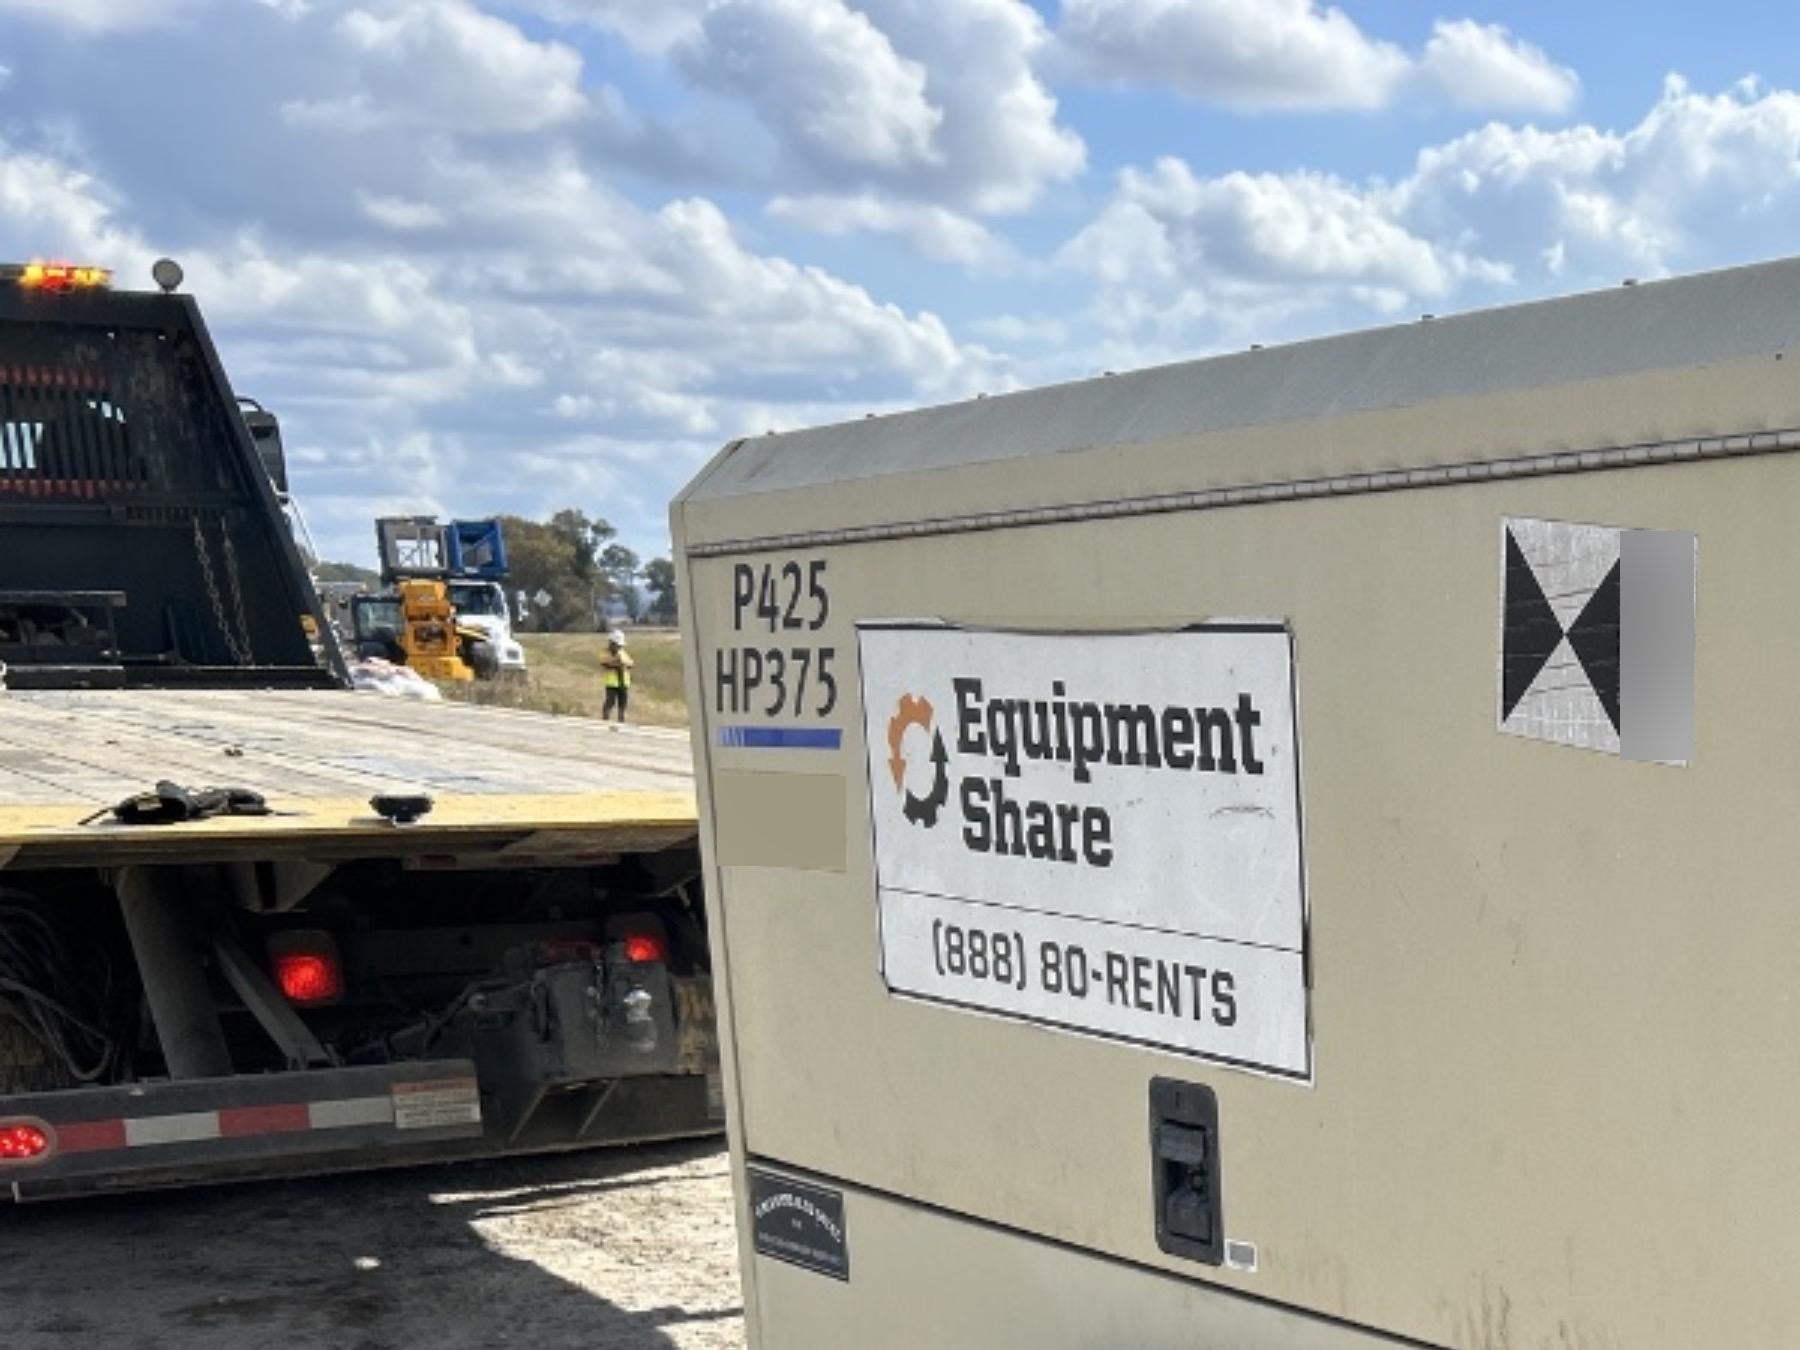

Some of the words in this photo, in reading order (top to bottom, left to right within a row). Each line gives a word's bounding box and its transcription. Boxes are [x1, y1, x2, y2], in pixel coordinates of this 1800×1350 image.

[733, 560, 830, 632] P425
[715, 646, 838, 718] HP375
[952, 677, 1264, 783] Equipment
[958, 777, 1115, 868] Share
[931, 918, 1027, 991] (888)
[1039, 941, 1238, 1027] 80-RENTS
